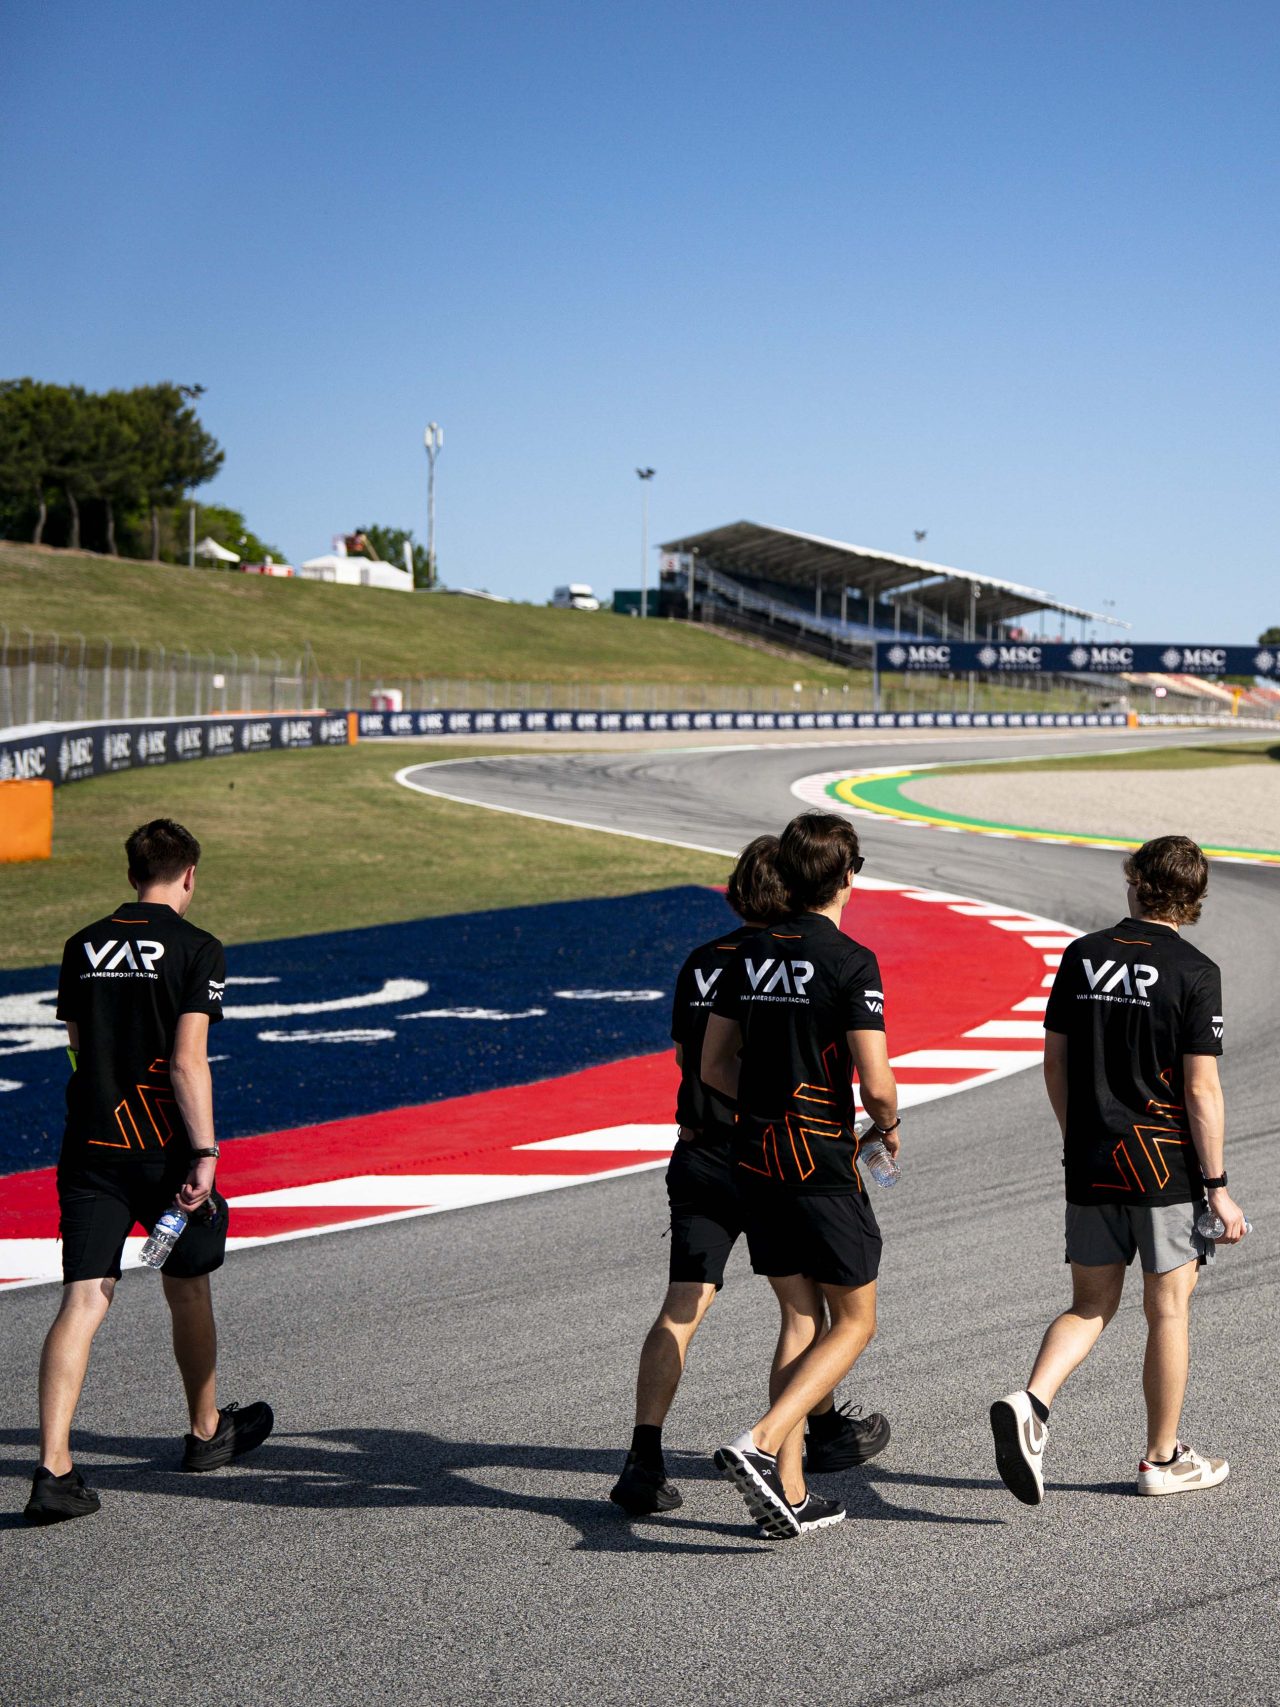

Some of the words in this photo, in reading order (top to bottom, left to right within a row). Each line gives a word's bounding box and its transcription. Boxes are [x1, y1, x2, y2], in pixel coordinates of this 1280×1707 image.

[908, 645, 951, 663] MSC
[999, 646, 1042, 664] MSC
[1091, 647, 1134, 665] MSC
[1182, 649, 1226, 667] MSC
[70, 737, 94, 767] MSC
[14, 746, 46, 779] MSC
[83, 939, 165, 971] VAR
[135, 972, 159, 980] RACING
[744, 957, 815, 995] VAR
[1081, 958, 1159, 998] VAR
[751, 994, 788, 1003] AMERSFOORT
[788, 997, 811, 1005] RACING
[1089, 994, 1129, 1003] AMERSFOORT
[1128, 998, 1151, 1007] RACING
